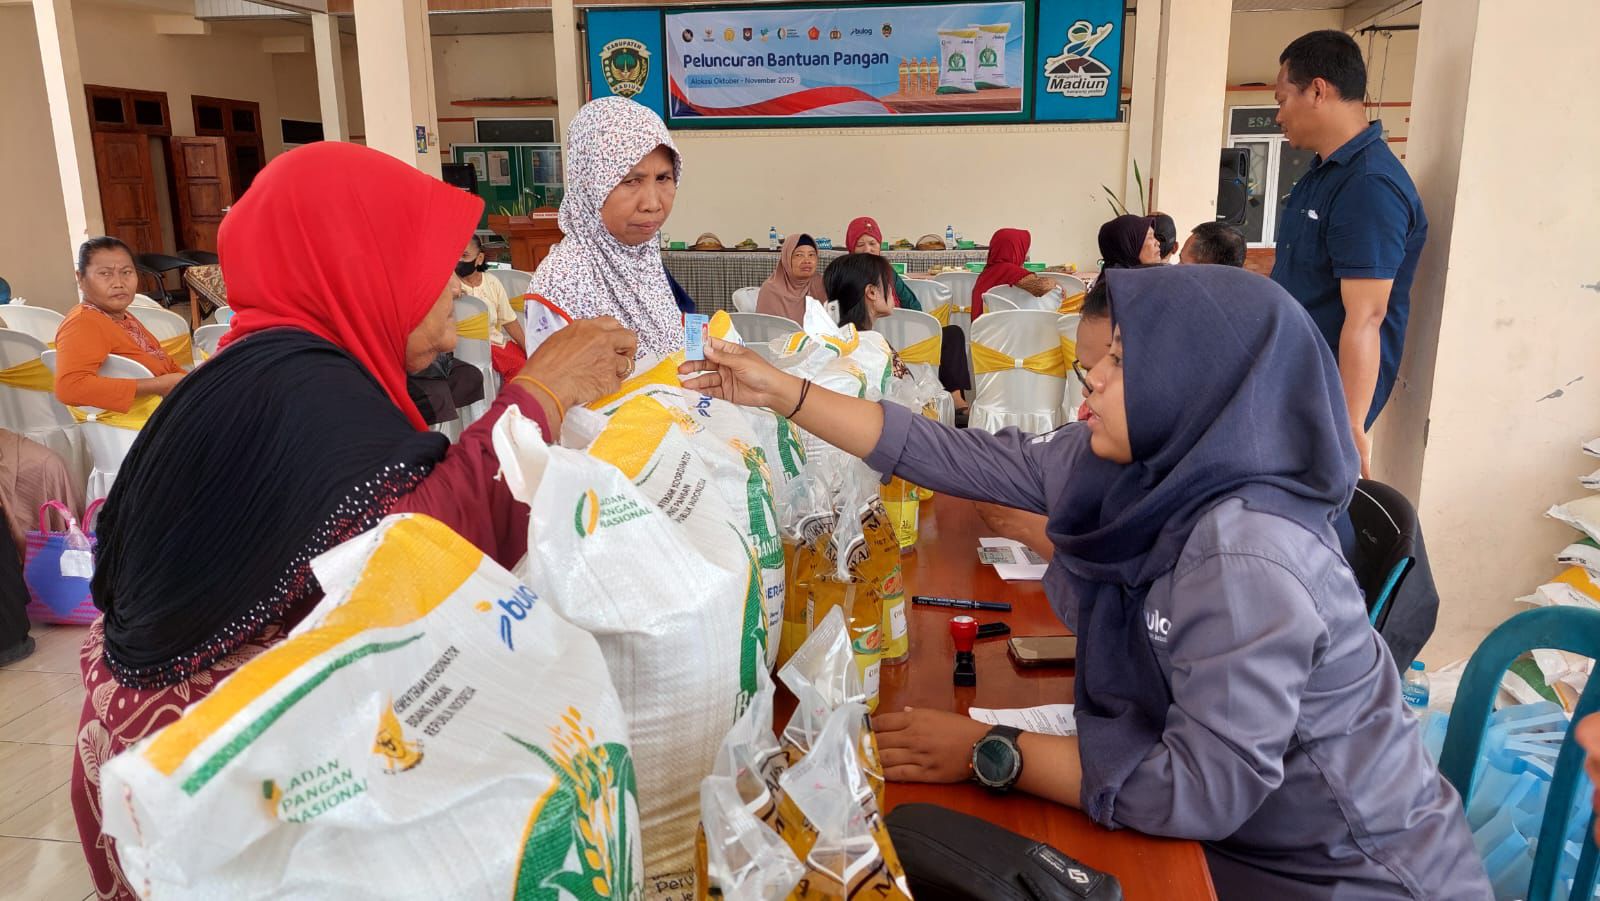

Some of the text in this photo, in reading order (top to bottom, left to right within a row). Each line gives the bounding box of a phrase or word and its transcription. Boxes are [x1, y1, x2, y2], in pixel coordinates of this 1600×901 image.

[683, 52, 889, 69] Peluncuran Bantuan Pangan
[690, 77, 713, 85] Alokasi
[713, 77, 739, 85] Oktober
[778, 76, 795, 84] 2025
[1050, 78, 1105, 89] Madiun
[601, 499, 639, 516] ANGAN
[1146, 609, 1172, 636] ulo
[286, 759, 340, 792] ADAN
